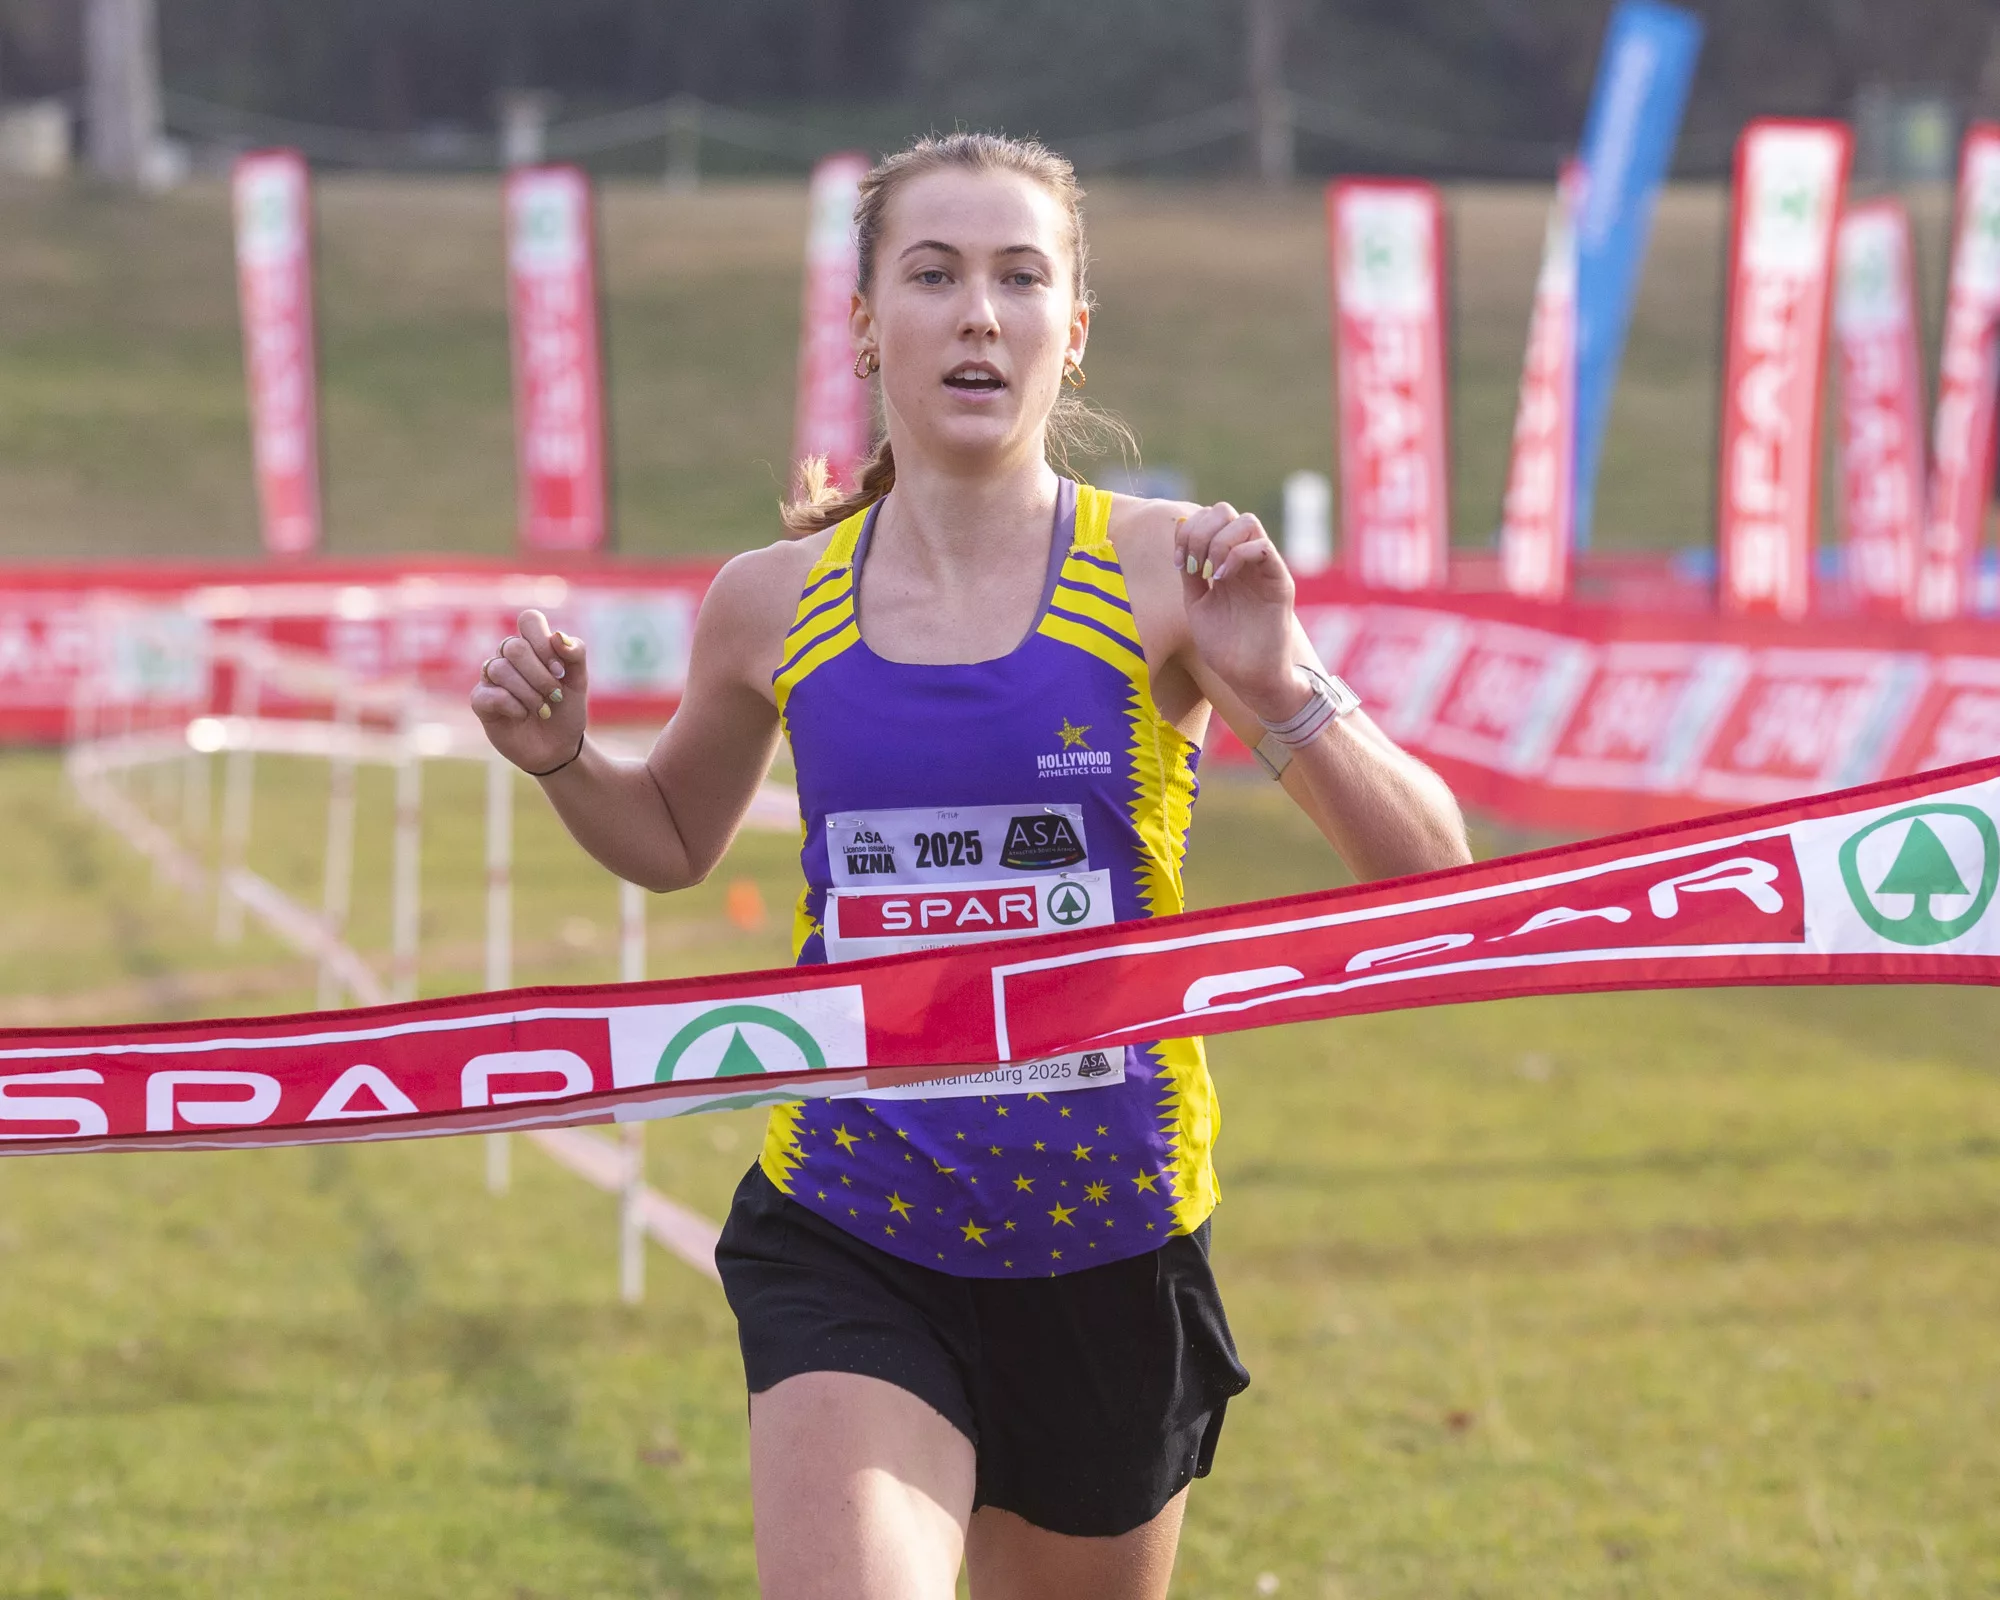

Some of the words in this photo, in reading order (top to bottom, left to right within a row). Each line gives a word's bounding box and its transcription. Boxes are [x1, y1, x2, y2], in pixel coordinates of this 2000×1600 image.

[1037, 751, 1111, 769] HOLLYWOOD
[1038, 766, 1089, 778] ATHLETICS
[1091, 766, 1112, 774] CLUB
[853, 831, 884, 844] ASA
[1011, 820, 1073, 849] ASA
[842, 844, 867, 854] License
[887, 844, 895, 854] by
[914, 830, 983, 868] 2025
[846, 853, 897, 875] KZNA
[881, 893, 1034, 930] SPAR
[1081, 1054, 1107, 1069] ASA
[1028, 1063, 1072, 1080] 2025
